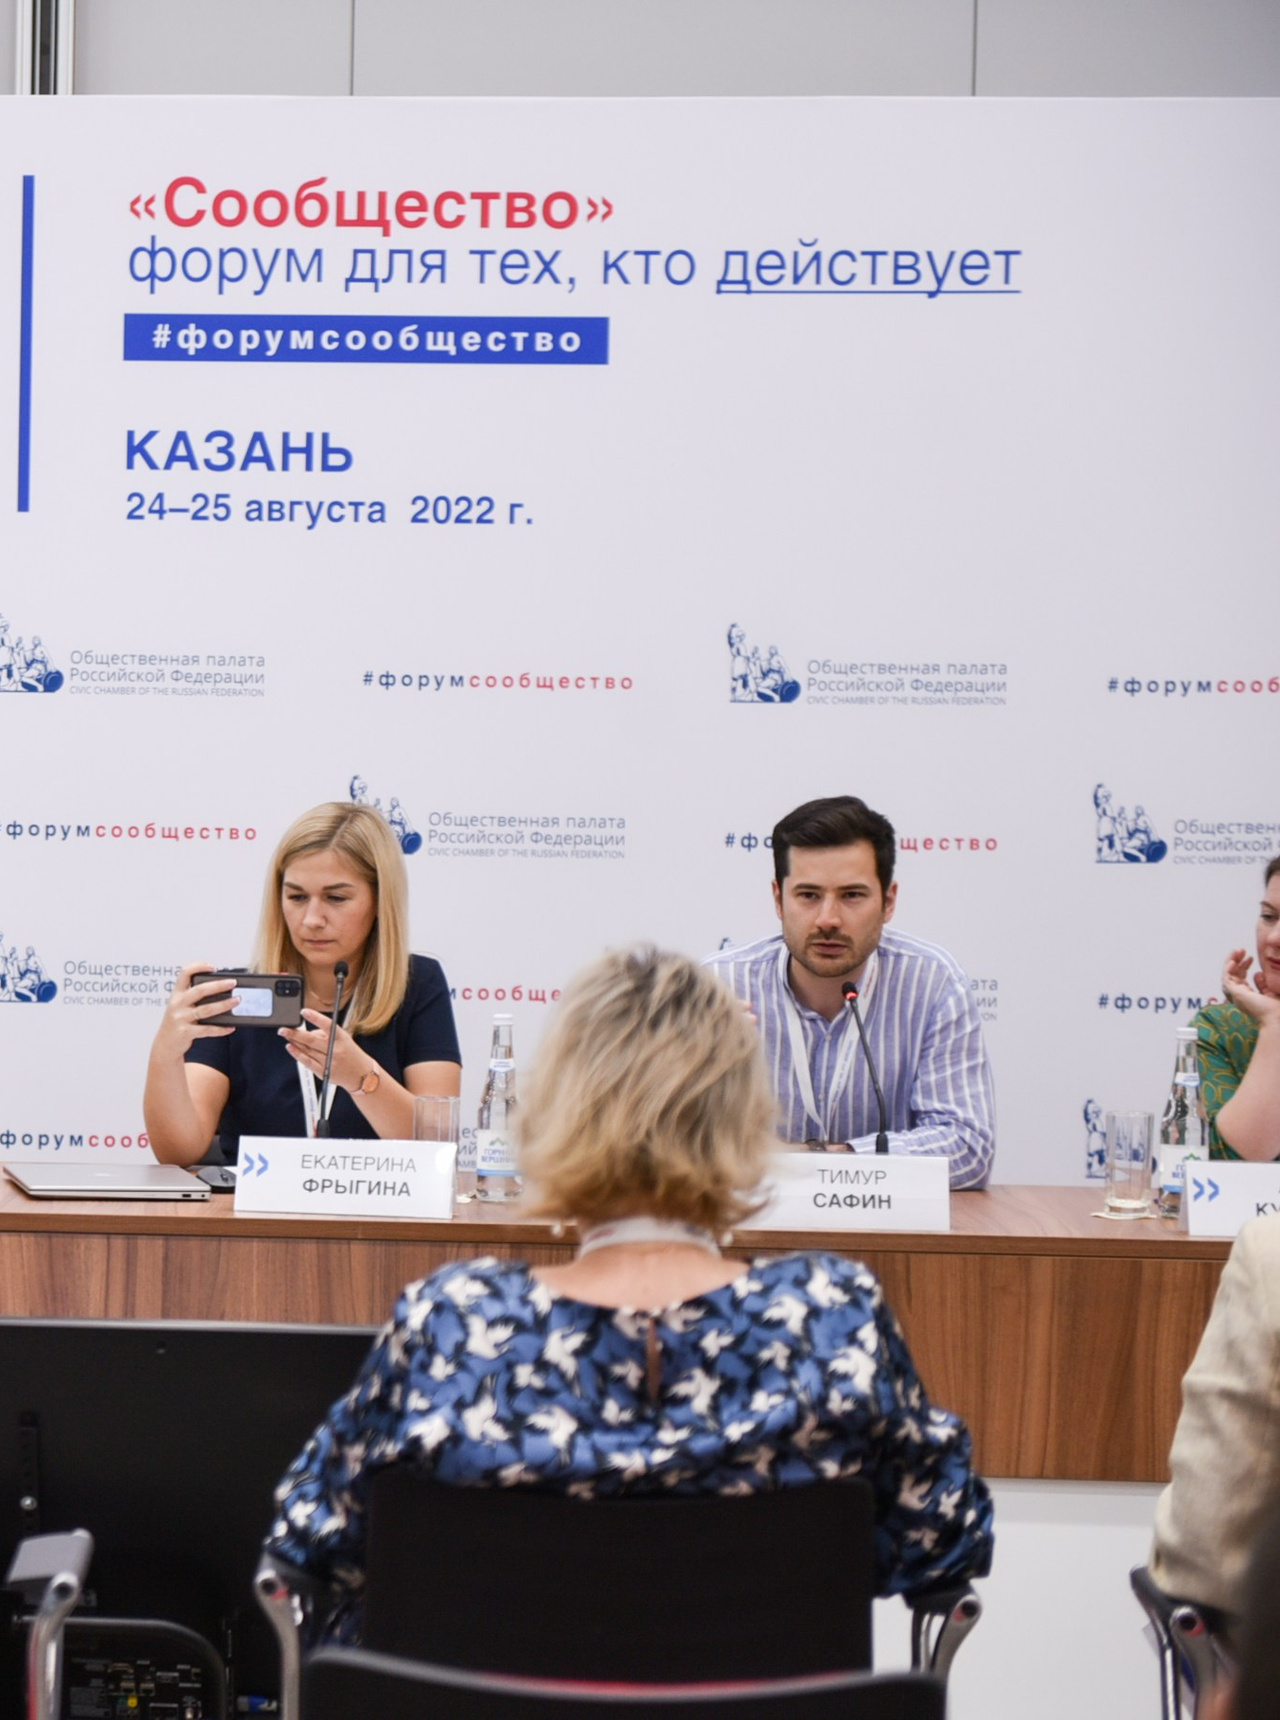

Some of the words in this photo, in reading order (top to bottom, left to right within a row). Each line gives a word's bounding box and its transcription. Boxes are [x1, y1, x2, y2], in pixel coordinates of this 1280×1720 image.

[129, 176, 614, 237] «Сообщество»
[129, 235, 322, 296] форум
[345, 249, 446, 292] для
[469, 249, 577, 293] тех,
[603, 250, 695, 285] кто
[716, 239, 1021, 299] действует
[152, 322, 581, 355] #форумсообщество
[127, 430, 353, 472] КАЗАНЬ
[245, 500, 386, 530] августа
[411, 495, 494, 524] 2022
[509, 503, 532, 524] г.
[70, 650, 200, 667] Общественная
[206, 655, 265, 667] палата
[70, 667, 165, 682] Российской
[170, 670, 264, 687] Федерации
[807, 660, 940, 677] Общественная
[947, 663, 1007, 675] палата
[363, 671, 632, 691] #форумсообщество
[807, 677, 905, 692] Российской
[910, 678, 1006, 696] Федерации
[429, 812, 559, 830] Общественная
[566, 817, 625, 829] палата
[1174, 819, 1280, 836] Общественн
[428, 829, 524, 844] Российской
[530, 831, 625, 850] Федерации
[1174, 837, 1273, 852] Российской
[64, 961, 182, 976] Общественна
[64, 978, 158, 993] Российской
[301, 1154, 416, 1172] ЕКАТЕРИНА
[817, 1169, 887, 1185] ТИМУР
[303, 1179, 410, 1196] ФРЫГИНА
[813, 1193, 891, 1209] САФИН
